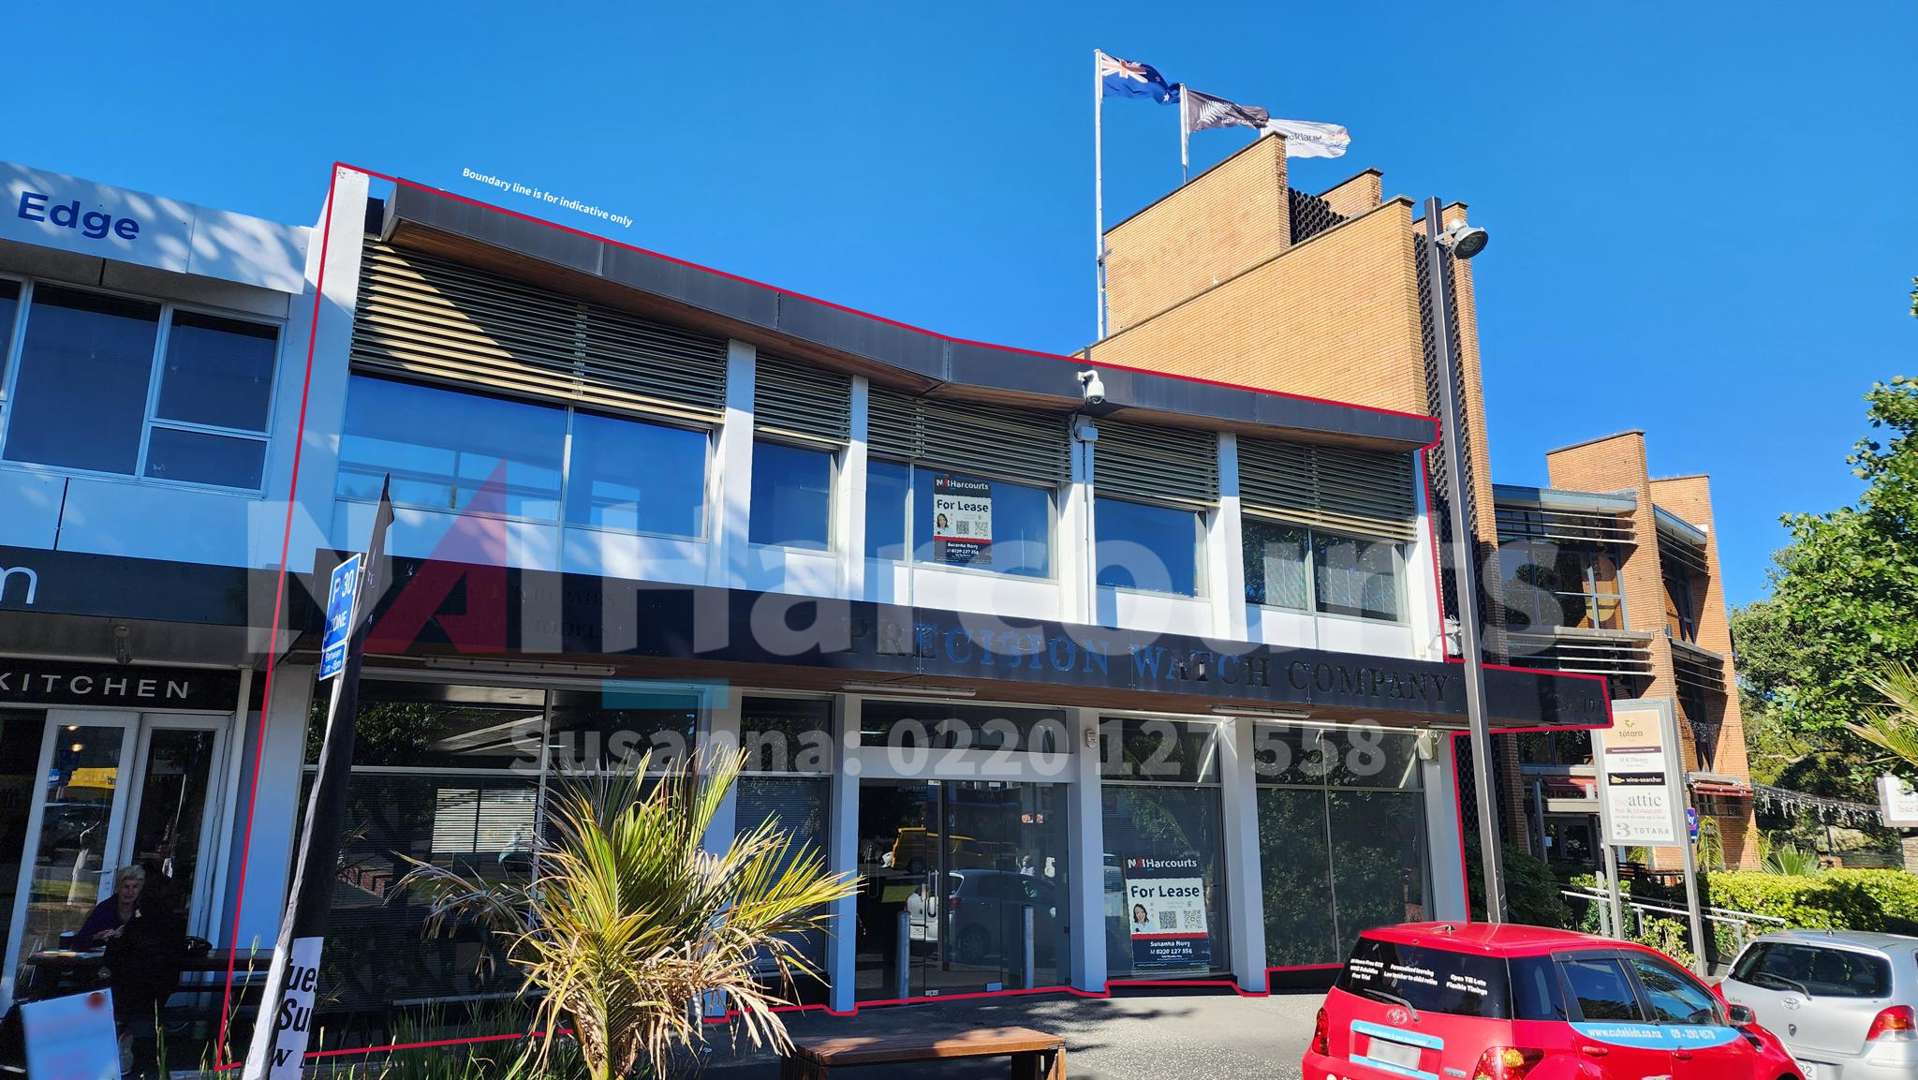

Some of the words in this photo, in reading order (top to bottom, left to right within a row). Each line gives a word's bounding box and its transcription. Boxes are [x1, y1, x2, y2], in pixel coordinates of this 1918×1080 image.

[17, 191, 140, 240] Edge
[937, 500, 955, 510] For
[958, 501, 989, 513] Lease
[342, 569, 354, 598] 30
[846, 615, 1108, 674] PRECISION
[1130, 643, 1271, 687] WATCH
[1288, 660, 1448, 701] COMPANY
[1628, 792, 1663, 807] attic
[1146, 858, 1198, 868] Harcourts
[1131, 885, 1155, 898] For
[1159, 885, 1200, 898] Lease
[1450, 974, 1464, 982] Open
